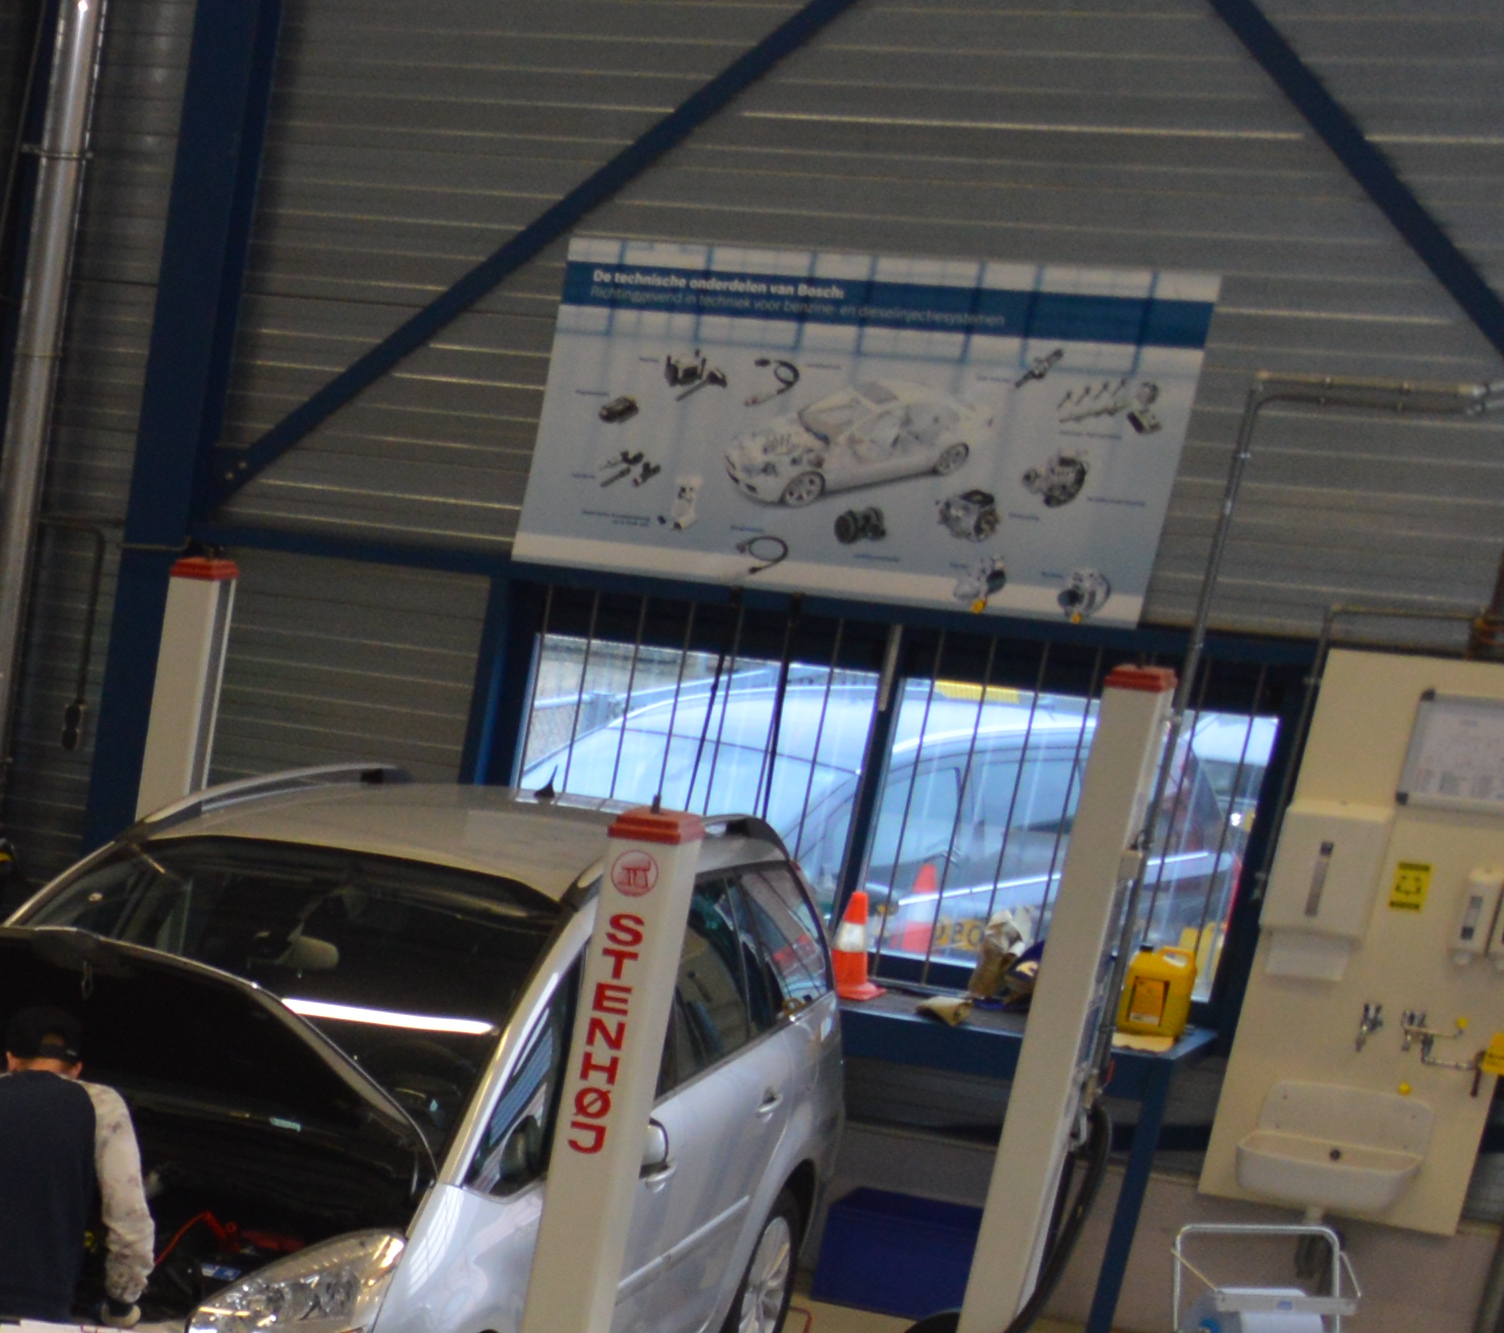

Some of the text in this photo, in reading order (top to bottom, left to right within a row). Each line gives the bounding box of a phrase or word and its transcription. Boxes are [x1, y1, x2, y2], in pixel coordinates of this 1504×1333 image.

[593, 269, 612, 283] De
[614, 271, 687, 289] technische
[689, 277, 768, 295] onderdelen
[769, 283, 795, 296] van
[568, 912, 645, 1155] STENHØJ
